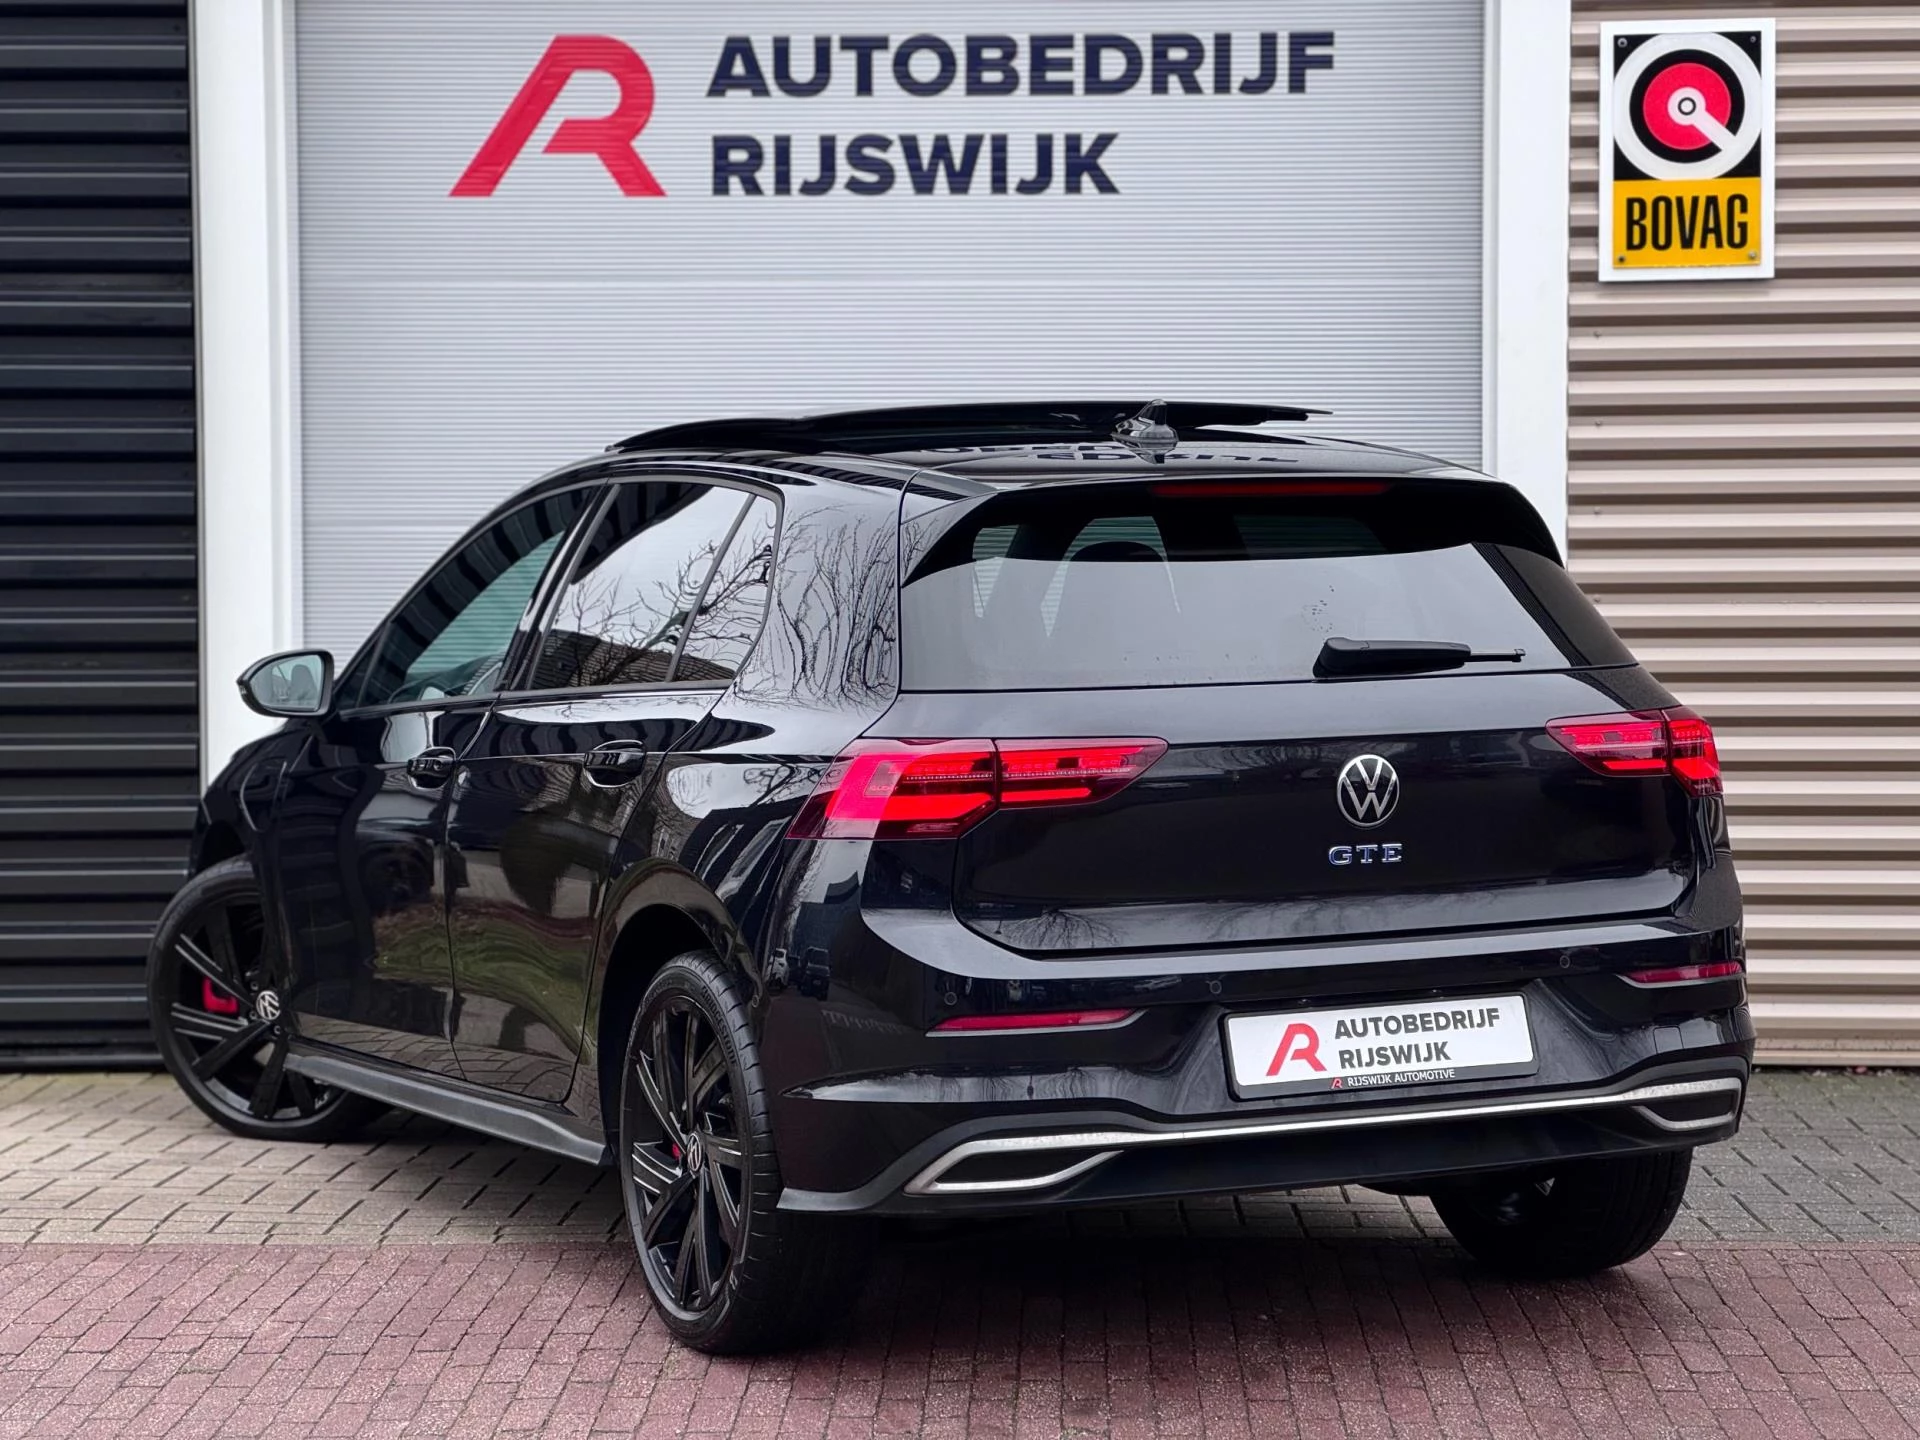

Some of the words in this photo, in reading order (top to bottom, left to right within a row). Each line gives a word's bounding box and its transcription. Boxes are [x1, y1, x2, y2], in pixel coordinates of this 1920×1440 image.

[707, 32, 1334, 97] AUTOBEDRIJF
[712, 134, 1120, 195] RIJSWIJK
[1626, 194, 1748, 250] BOVAG
[1328, 843, 1402, 866] GTE
[1334, 1007, 1500, 1040] AUTOBEDRIJF
[1338, 1041, 1451, 1070] RIJSWIJK
[1347, 1074, 1392, 1087] RIJSWIJK
[1394, 1069, 1455, 1083] AUTOMOTIVE
